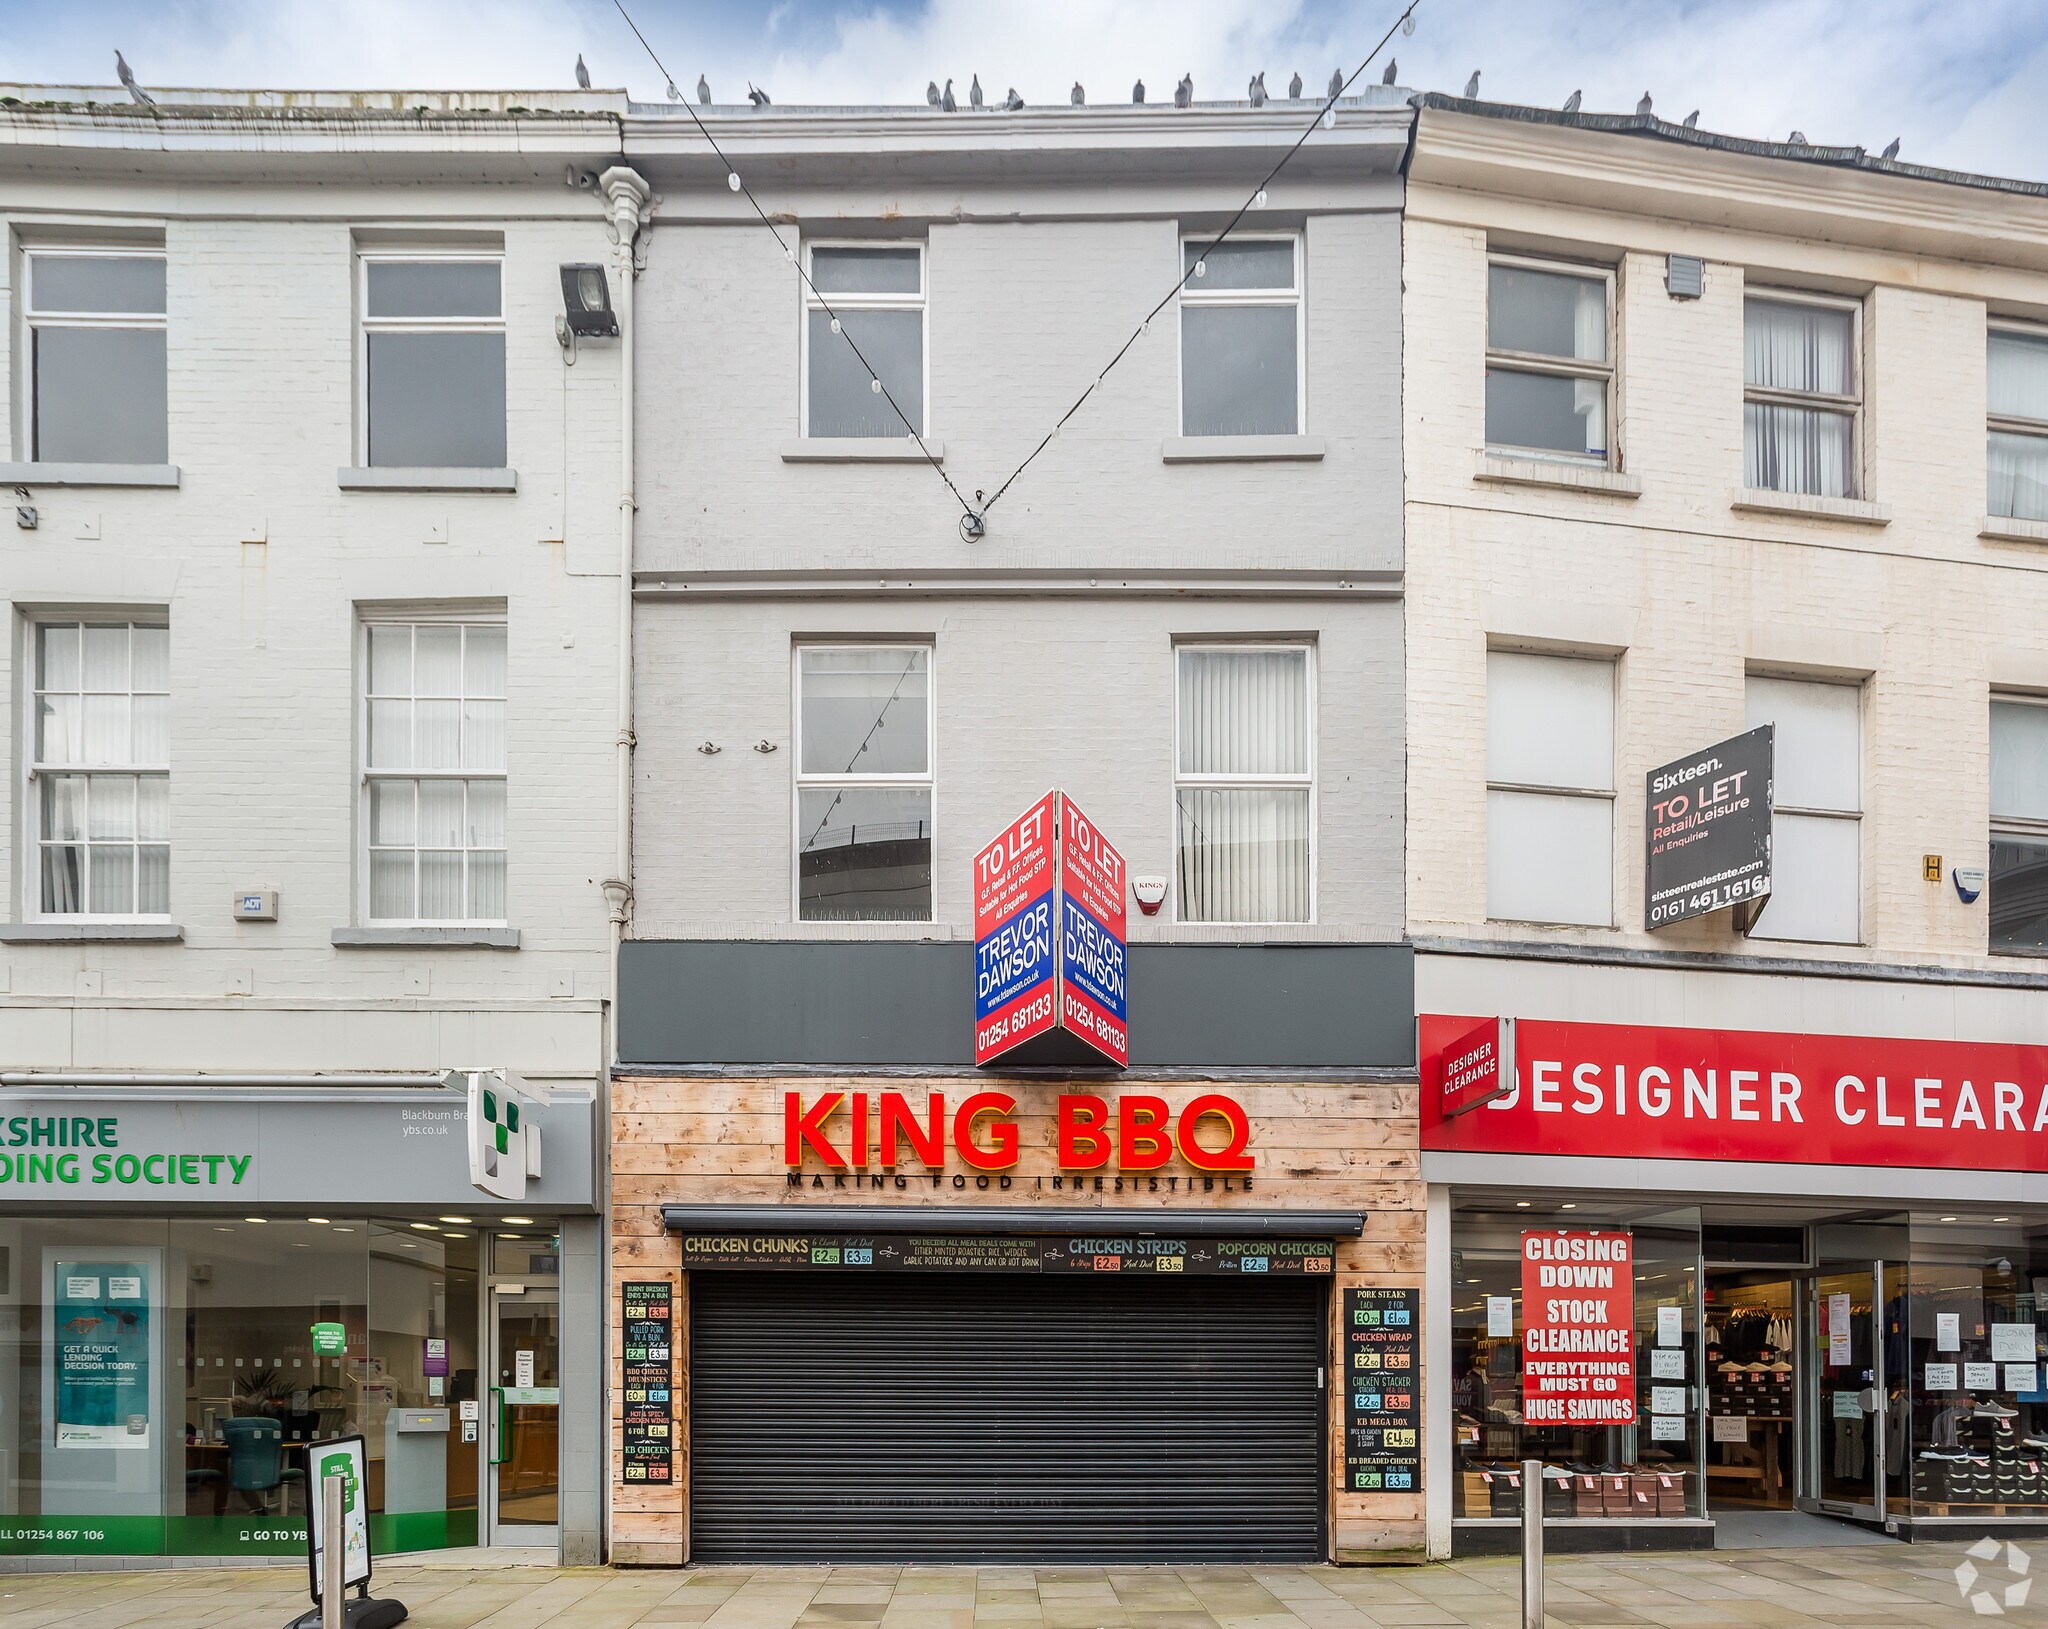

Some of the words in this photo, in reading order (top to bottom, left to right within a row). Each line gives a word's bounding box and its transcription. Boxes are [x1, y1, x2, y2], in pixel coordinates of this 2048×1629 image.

[1653, 757, 1723, 794] Sixteen.
[1653, 795, 1689, 823] TO
[1699, 770, 1747, 809] LET
[1653, 797, 1750, 841] Retail/Leisure
[979, 844, 1004, 883] TO
[1009, 805, 1045, 861] LET
[1067, 805, 1090, 852] TO
[1095, 834, 1120, 884] LET
[1653, 845, 1664, 855] All
[1667, 828, 1709, 850] Enquiries
[992, 874, 1006, 892] Retail
[1007, 869, 1011, 880] &
[1022, 845, 1043, 867] Offices
[1927, 858, 1939, 878] H
[980, 896, 999, 917] Suitable
[1008, 881, 1018, 895] Hot
[1019, 870, 1033, 887] Food
[1034, 857, 1046, 873] STP
[1651, 859, 1763, 902] sixteenrealestate.com
[244, 899, 260, 908] ADT
[1004, 891, 1027, 911] Enquiries
[1651, 899, 1685, 921] 0161
[1690, 888, 1719, 909] 461
[1724, 874, 1762, 900] 1616
[979, 902, 1048, 969] TREVOR
[1066, 901, 1123, 974] TREVOR
[979, 929, 1049, 999] DAWSON
[1066, 931, 1124, 1000] DAWSON
[988, 969, 1039, 1008] www.tdawson.co.uk
[979, 1017, 1009, 1051] 01254
[1012, 993, 1051, 1033] 681133
[1066, 994, 1094, 1031] 01254
[1096, 1016, 1125, 1052] 681133
[1448, 1042, 1491, 1077] DESIGNER
[1444, 1058, 1496, 1095] CLEARANCE
[402, 1110, 451, 1120] Blackburn
[403, 1125, 448, 1137] ybs.co.uk
[784, 1091, 1019, 1171] KING
[1058, 1094, 1255, 1171] BBQ
[92, 1154, 252, 1184] SOCIETY
[787, 1172, 907, 1190] MAKING
[933, 1174, 1012, 1190] FOOD
[1038, 1176, 1254, 1192] IRRESISTIBLE
[685, 1238, 748, 1252] CHICKEN
[753, 1239, 808, 1253] CHUNKS
[915, 1247, 932, 1255] EITHER
[935, 1247, 956, 1256] MINTED
[1069, 1239, 1132, 1254] CHICKEN
[1137, 1240, 1187, 1255] STRIPS
[1218, 1243, 1276, 1255] POPCORN
[1280, 1243, 1333, 1255] CHICKEN
[1525, 1238, 1627, 1261] CLOSING
[814, 1251, 837, 1262] £2.50
[846, 1251, 871, 1263] £3.50
[925, 1257, 952, 1266] POTATOES
[955, 1257, 967, 1266] AND
[970, 1257, 981, 1266] ANY
[984, 1258, 996, 1266] CAN
[999, 1258, 1006, 1266] OR
[1022, 1258, 1039, 1267] DRINK
[1096, 1257, 1118, 1270] £2.50
[1159, 1258, 1181, 1270] £3.50
[1242, 1259, 1266, 1270] £2.50
[1306, 1260, 1329, 1270] £3.50
[1540, 1265, 1613, 1288] DOWN
[1356, 1312, 1378, 1323] £0.70
[1388, 1312, 1406, 1323] £1.00
[1547, 1300, 1608, 1324] STOCK
[1352, 1333, 1386, 1341] CHICKEN
[1389, 1333, 1412, 1341] WRAP
[1526, 1328, 1629, 1353] CLEARANCE
[1993, 1328, 2034, 1338] CLOSING
[1999, 1341, 2031, 1352] DOWN
[64, 1354, 102, 1362] LENDING
[64, 1362, 104, 1370] DECISION
[107, 1362, 137, 1370] TODAY.
[1357, 1356, 1378, 1367] £2.50
[1387, 1356, 1408, 1366] £3.50
[1526, 1362, 1630, 1376] EVERYTHING
[1353, 1377, 1379, 1387] CHICKEN
[1382, 1377, 1411, 1387] STACKER
[1540, 1378, 1589, 1391] MUST
[1593, 1378, 1617, 1391] GO
[1357, 1396, 1379, 1407] £2.50
[1387, 1396, 1409, 1407] £3.50
[1526, 1399, 1565, 1420] HUGE
[1568, 1399, 1633, 1420] SAVINGS
[1357, 1418, 1367, 1426] KB
[1370, 1418, 1390, 1426] MEGA
[1393, 1418, 1408, 1426] BOX
[1386, 1432, 1414, 1445] £4.50
[331, 1464, 344, 1473] STILL
[1358, 1475, 1380, 1486] £2.50
[1387, 1475, 1409, 1486] £3.50
[16, 1530, 53, 1540] 01254
[56, 1530, 78, 1540] 867
[82, 1530, 104, 1540] 106
[254, 1530, 270, 1541] GO
[273, 1530, 289, 1541] TO
